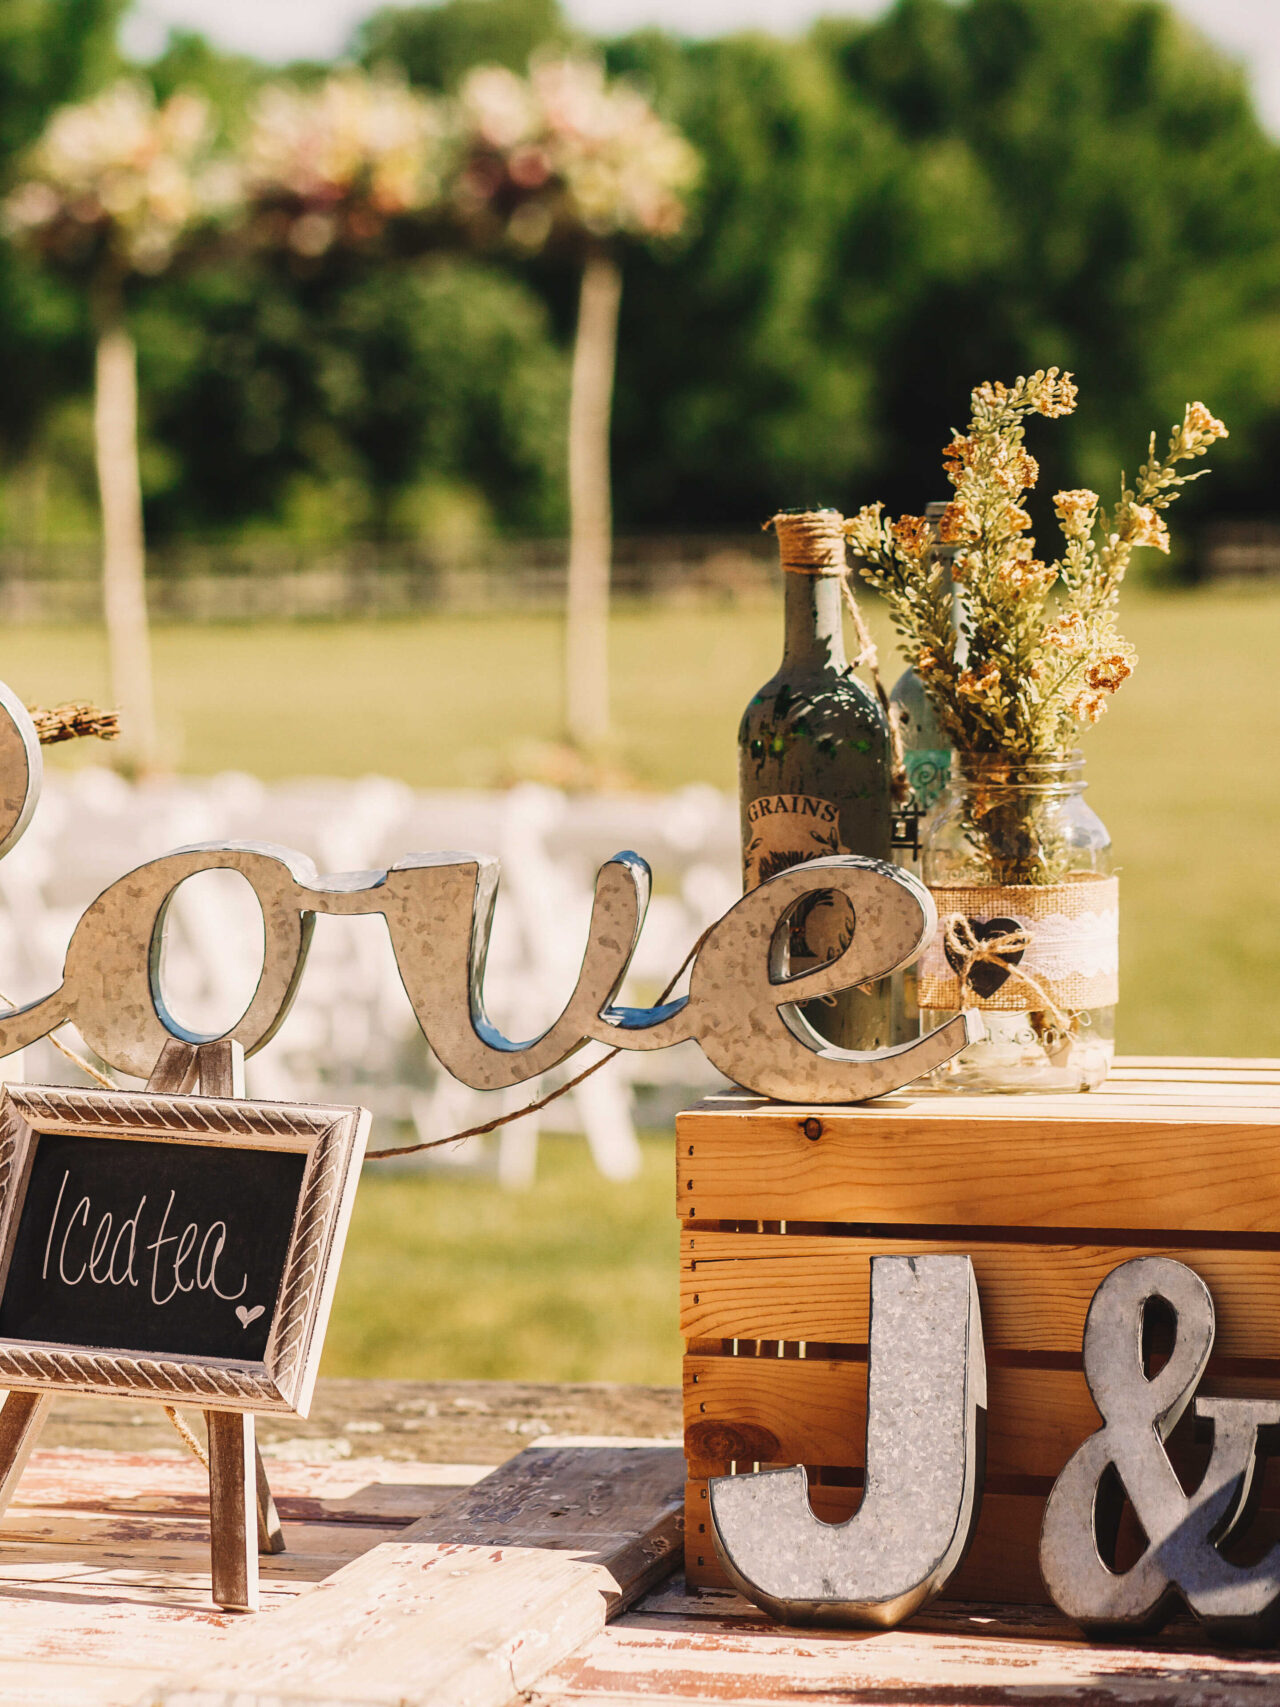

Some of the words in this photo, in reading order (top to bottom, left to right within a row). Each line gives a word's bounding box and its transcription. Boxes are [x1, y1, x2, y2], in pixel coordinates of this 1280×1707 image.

[748, 796, 838, 823] GRAINS
[42, 1169, 147, 1287] Iced
[146, 1189, 248, 1306] tea
[709, 1255, 986, 1629] J
